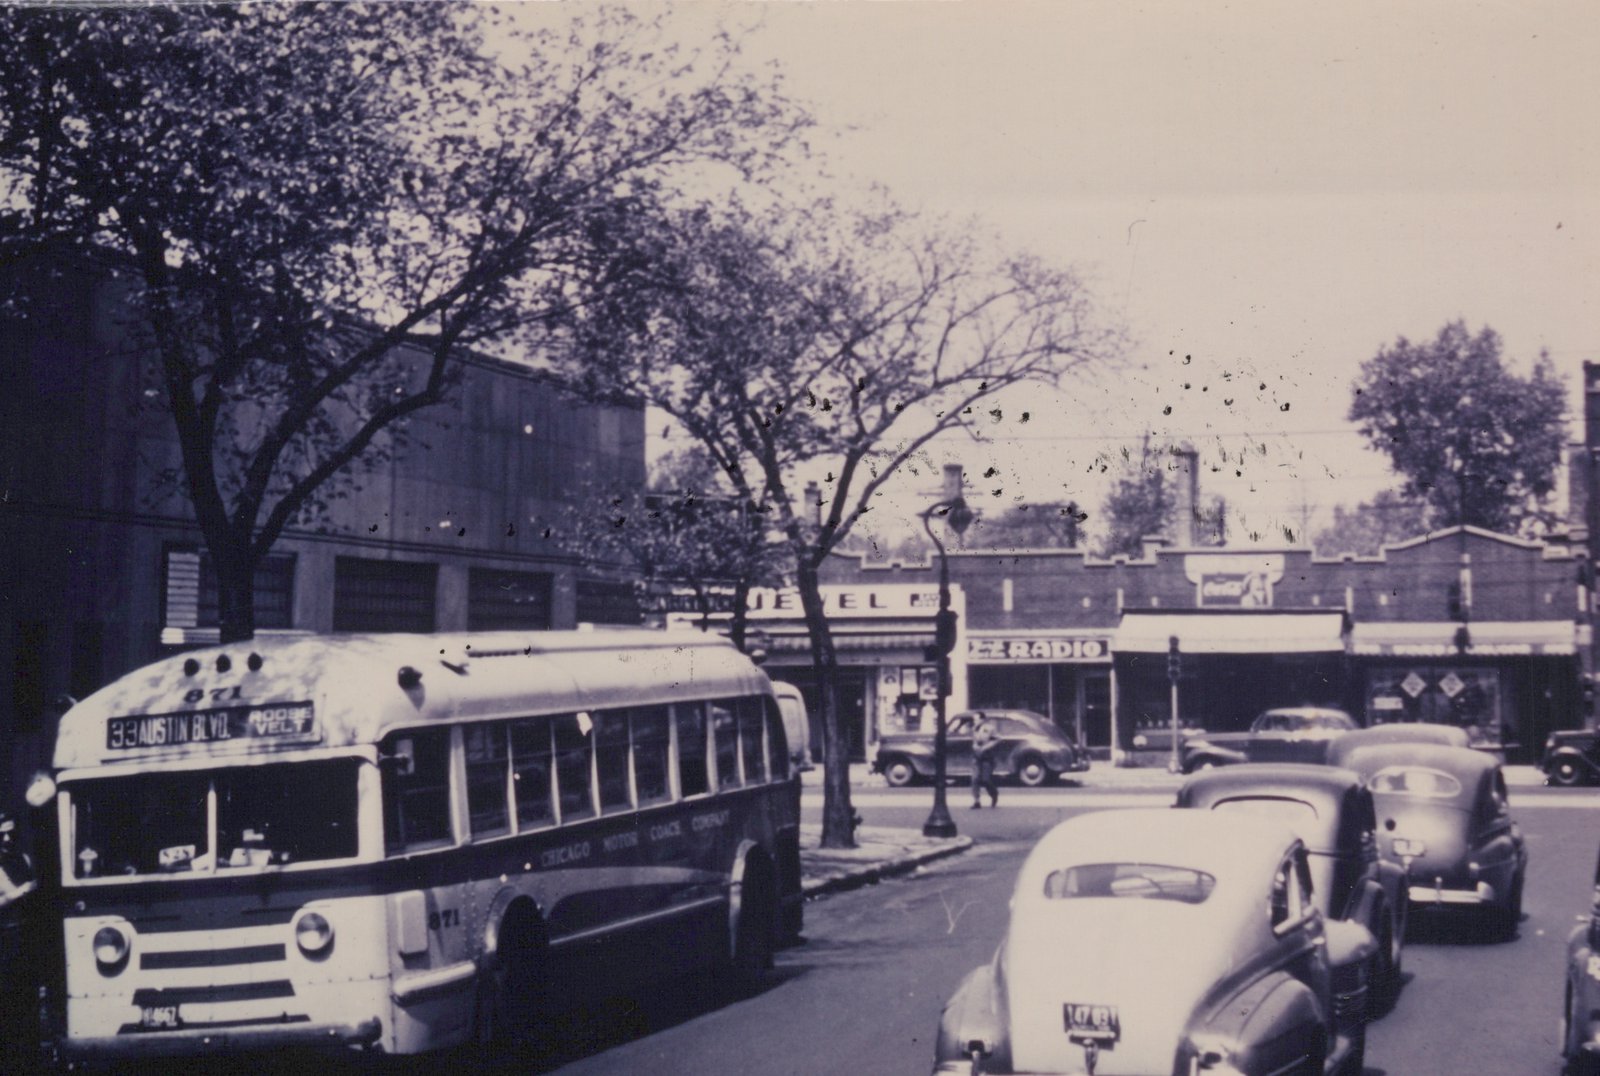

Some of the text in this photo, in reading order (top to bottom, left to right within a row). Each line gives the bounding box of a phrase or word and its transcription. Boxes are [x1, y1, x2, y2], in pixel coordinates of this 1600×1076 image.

[751, 592, 888, 609] JEEL
[1008, 640, 1102, 658] RADIO
[184, 686, 242, 703] 871
[111, 720, 138, 747] 33
[139, 715, 188, 744] AUSTIN
[256, 720, 305, 736] VELT
[541, 841, 591, 866] CHICAGO
[429, 909, 461, 931] 871
